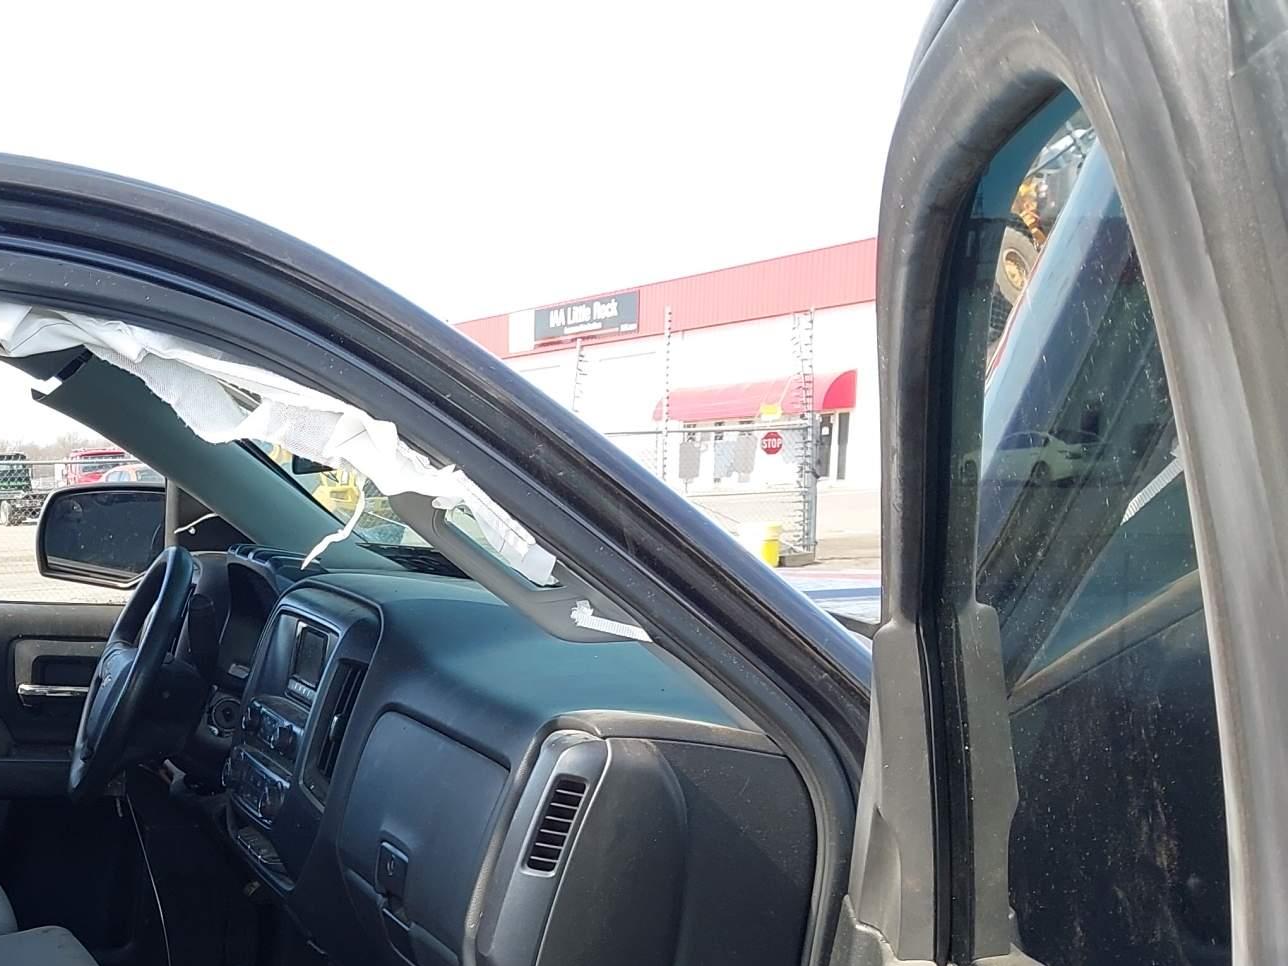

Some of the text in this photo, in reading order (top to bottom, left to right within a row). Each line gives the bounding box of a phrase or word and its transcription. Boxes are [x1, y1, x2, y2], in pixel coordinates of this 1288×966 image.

[567, 304, 592, 326] Little
[593, 299, 618, 321] Rock
[762, 438, 782, 449] STOP
